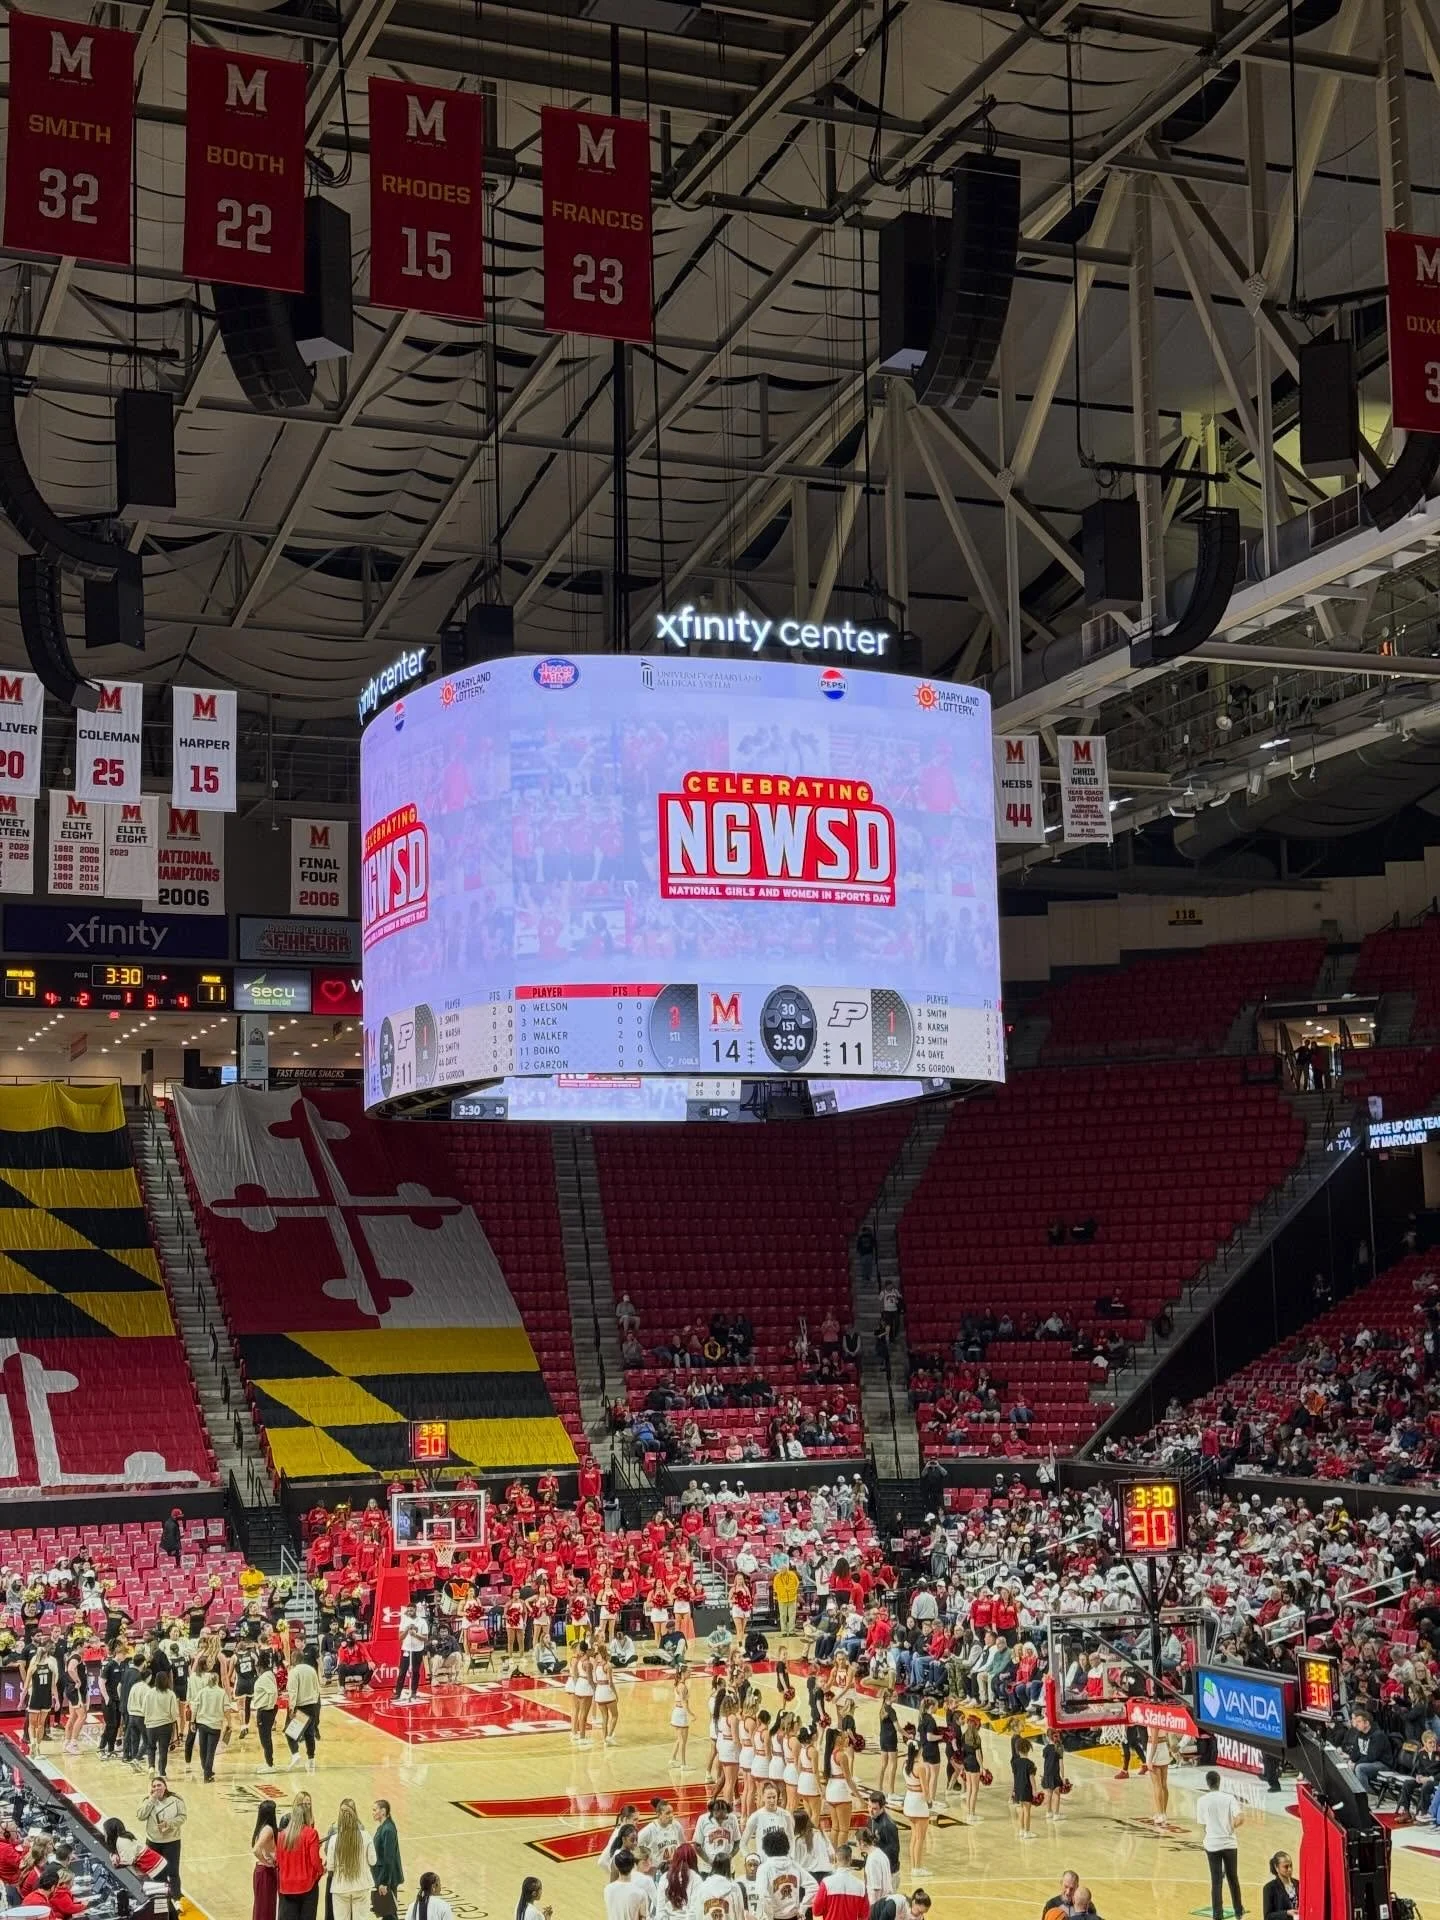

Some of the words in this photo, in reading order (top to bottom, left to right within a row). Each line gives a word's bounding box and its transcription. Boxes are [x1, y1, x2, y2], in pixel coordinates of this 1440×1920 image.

[28, 114, 111, 144] SMITH
[207, 145, 284, 175] BOOTH
[38, 168, 98, 224] 32
[382, 174, 471, 204] RHODES
[552, 200, 644, 231] FRANCIS
[217, 198, 272, 254] 22
[402, 226, 451, 280] 15
[572, 254, 623, 305] 23
[657, 606, 772, 651] xfinity
[780, 621, 889, 656] center
[380, 648, 426, 695] center
[456, 672, 491, 690] MARYLAND
[820, 680, 846, 690] PEPSI
[938, 691, 980, 706] MARYLAND
[79, 728, 140, 744] COLEMAN
[180, 738, 230, 750] HARPER
[92, 758, 124, 786] 25
[1072, 768, 1096, 776] CHRIS
[190, 766, 219, 794] 15
[1002, 780, 1032, 788] HEISS
[688, 776, 870, 802] CELEBRATING
[1006, 804, 1032, 828] 44
[62, 822, 92, 830] ELITE
[118, 826, 146, 834] ELITE
[60, 831, 93, 840] EIGHT
[116, 834, 148, 844] EIGHT
[668, 800, 892, 883] NGWSD
[299, 857, 340, 870] FINAL
[301, 872, 338, 883] FOUR
[158, 888, 210, 906] 2006
[299, 890, 340, 906] 2006
[668, 886, 722, 896] NATIONAL
[724, 887, 756, 897] GIRLS
[758, 888, 780, 898] AND
[783, 888, 819, 899] WOMEN
[822, 890, 832, 900] IN
[834, 891, 870, 902] SPORTS
[872, 893, 891, 904] DAY
[1176, 910, 1196, 920] 118
[66, 916, 169, 950] xfinity
[106, 968, 141, 985] 3:30
[18, 980, 34, 996] 14
[210, 986, 225, 1001] 11
[251, 987, 296, 998] secu
[489, 992, 500, 1001] PTS
[532, 988, 562, 998] PLAYER
[612, 986, 628, 996] PTS
[79, 993, 89, 1006] 2
[147, 994, 156, 1008] 3
[178, 996, 188, 1008] 4
[532, 1002, 568, 1012] WELSON
[926, 995, 948, 1005] PLAYER
[709, 992, 742, 1025] M
[782, 1004, 795, 1016] 30
[828, 1002, 868, 1028] P
[926, 1009, 946, 1018] SMITH
[445, 1014, 460, 1024] SMITH
[534, 1018, 558, 1026] MACK
[782, 1022, 795, 1031] 1ST
[928, 1022, 949, 1032] KARSH
[534, 1032, 568, 1040] WALKER
[773, 1034, 806, 1050] 3:30
[916, 1036, 925, 1044] 23
[928, 1036, 948, 1046] SMITH
[446, 1042, 460, 1052] SMITH
[520, 1048, 529, 1056] 11
[534, 1046, 560, 1055] BOIKO
[712, 1040, 740, 1063] 14
[840, 1042, 862, 1066] 11
[916, 1050, 926, 1058] 44
[928, 1050, 944, 1060] DAYE
[520, 1062, 530, 1070] 12
[534, 1060, 568, 1070] GARZON
[916, 1064, 926, 1072] 55
[928, 1064, 955, 1074] GORDON
[276, 1069, 293, 1078] FAST
[294, 1070, 316, 1078] BREAK
[318, 1070, 344, 1078] SNACKS
[402, 1062, 412, 1086] 11
[446, 1070, 464, 1080] GORDON
[459, 1105, 480, 1116] 3:30
[495, 1106, 504, 1114] 30
[709, 1108, 721, 1116] 1ST
[1369, 1122, 1391, 1136] MAKE
[1392, 1121, 1404, 1134] UP
[1404, 1119, 1422, 1132] OUR
[1370, 1136, 1380, 1149] AT
[422, 1424, 445, 1436] 3:30
[419, 1436, 441, 1456] 30
[1136, 1486, 1174, 1508] 3:30
[1130, 1510, 1169, 1546] 30
[240, 1662, 252, 1673] 23
[38, 1674, 48, 1685] 11
[1311, 1682, 1327, 1706] 30
[1220, 1688, 1280, 1724] VANDA
